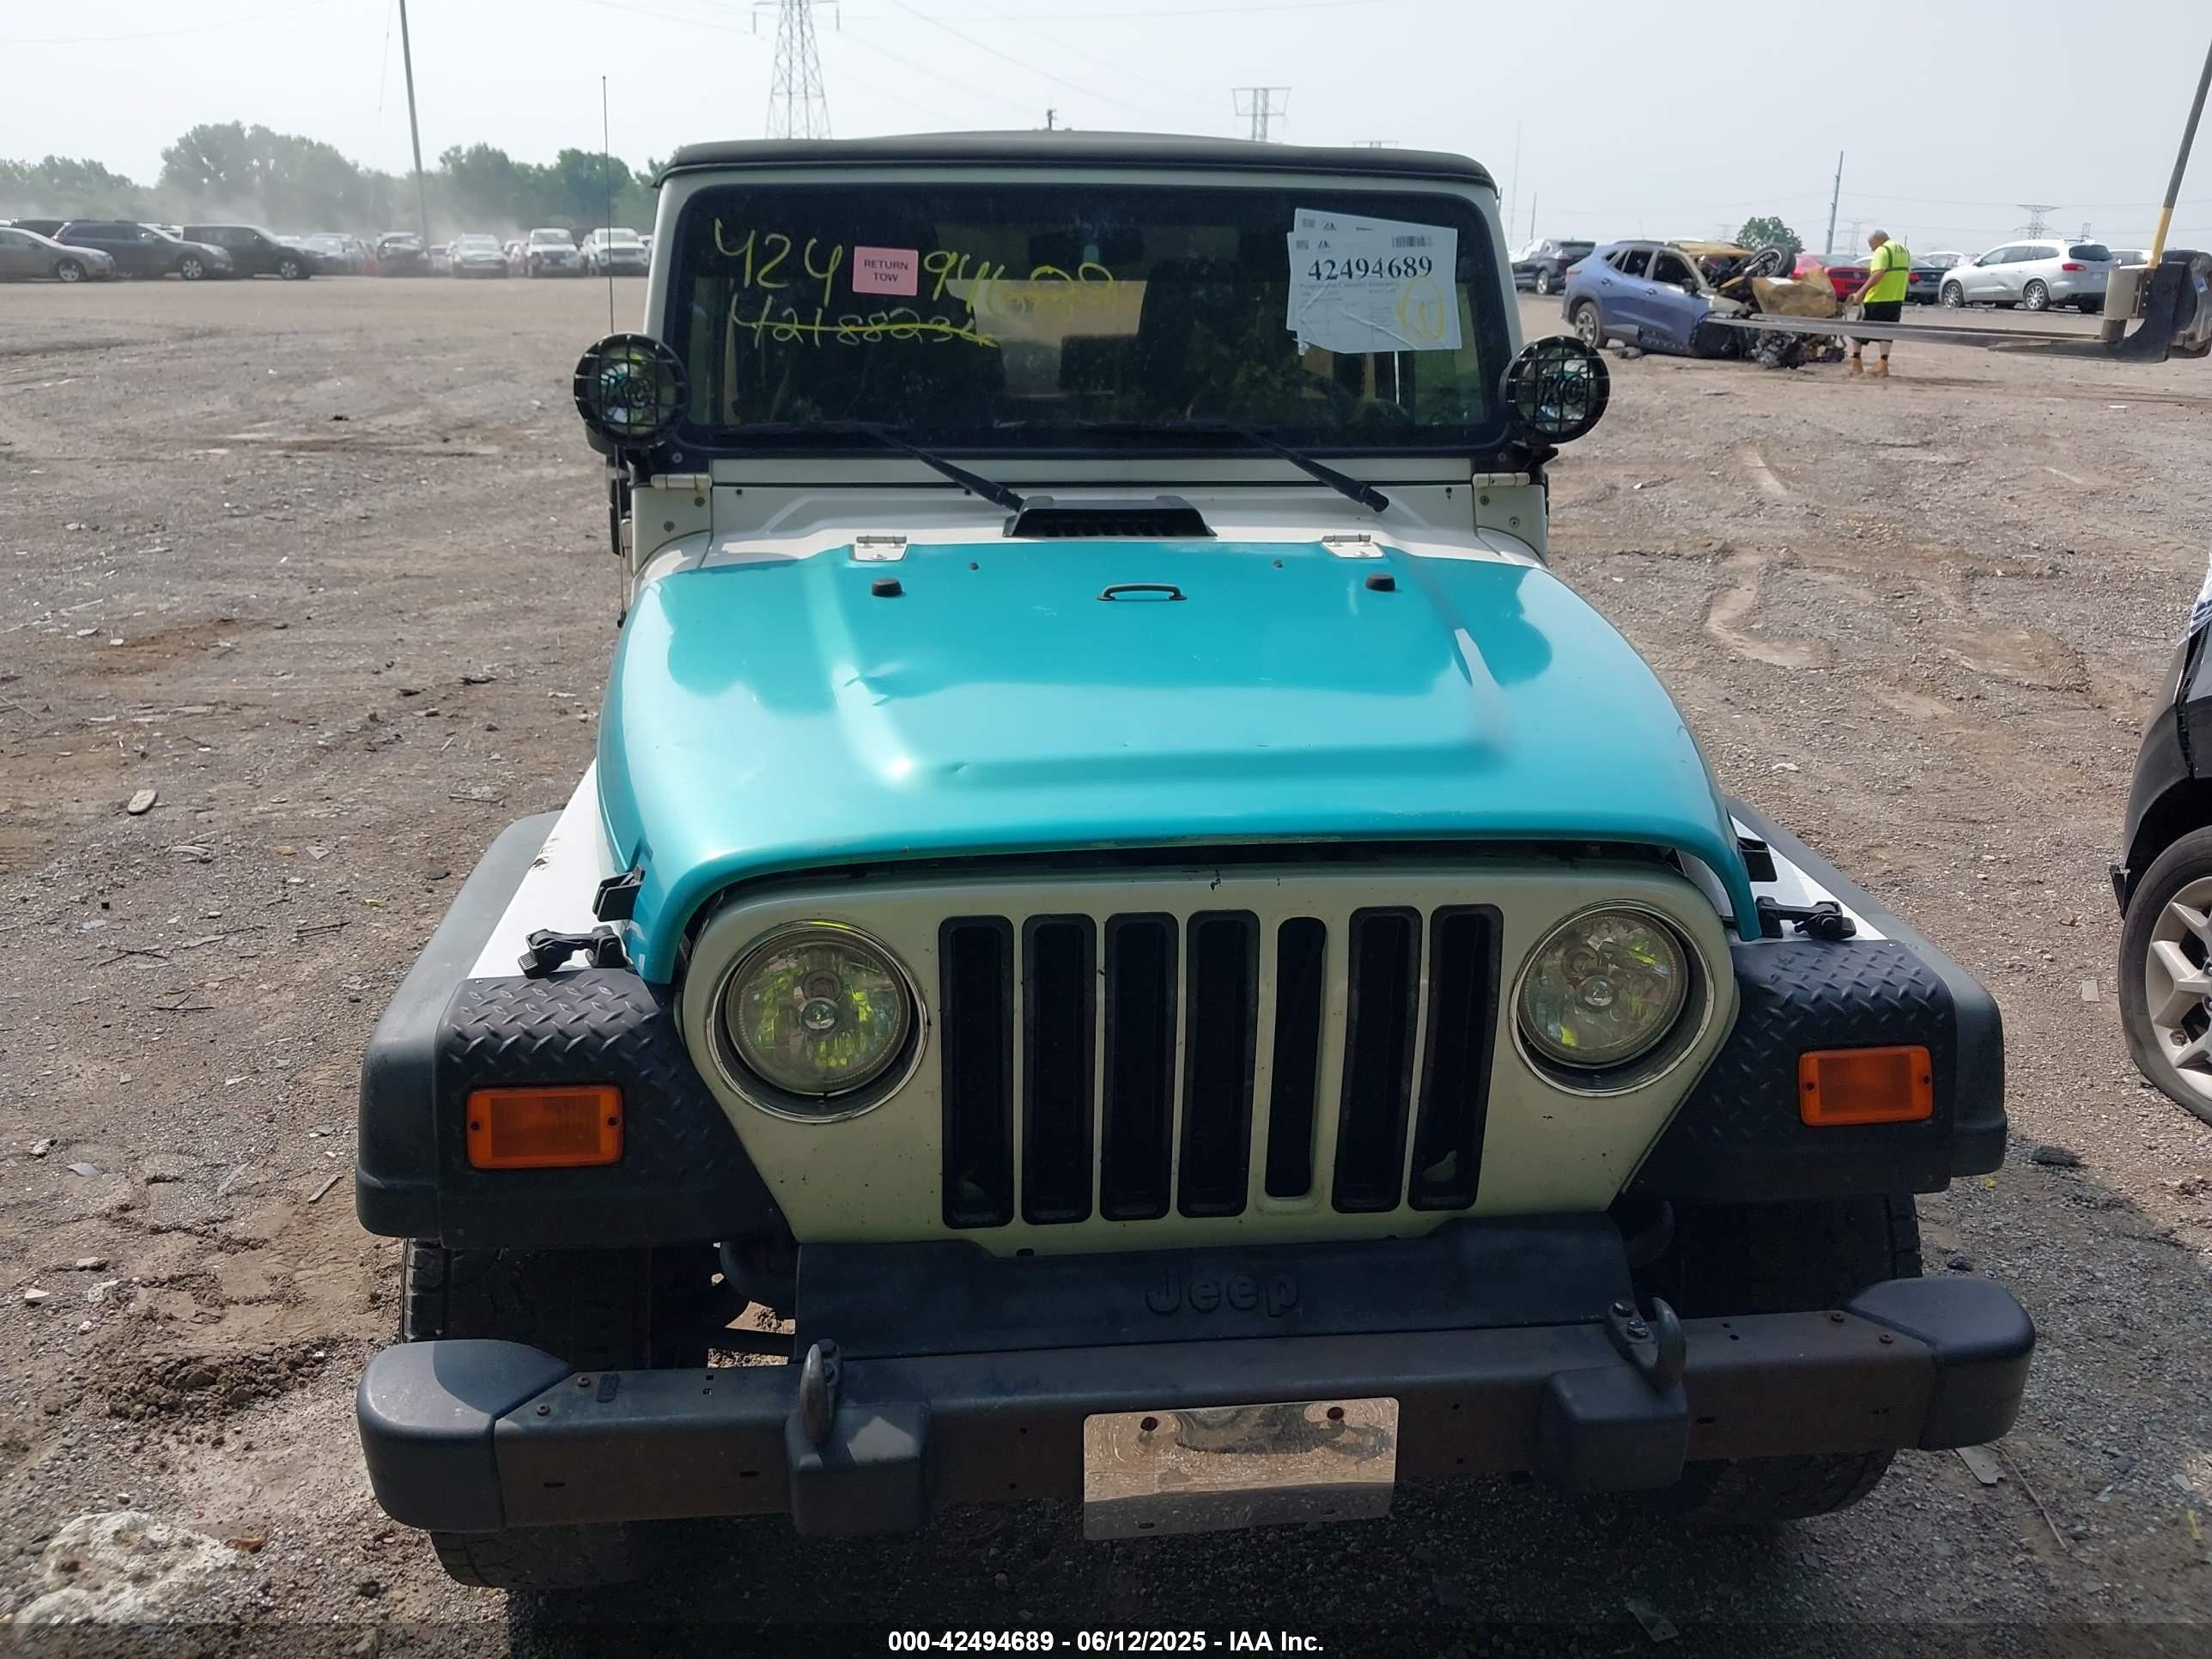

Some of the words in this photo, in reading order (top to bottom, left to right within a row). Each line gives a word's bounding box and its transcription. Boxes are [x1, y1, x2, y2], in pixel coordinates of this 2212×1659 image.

[864, 259, 909, 270] RETURN
[1307, 256, 1433, 282] 42494689
[874, 272, 899, 283] TOW
[1145, 1268, 1300, 1319] Jeep
